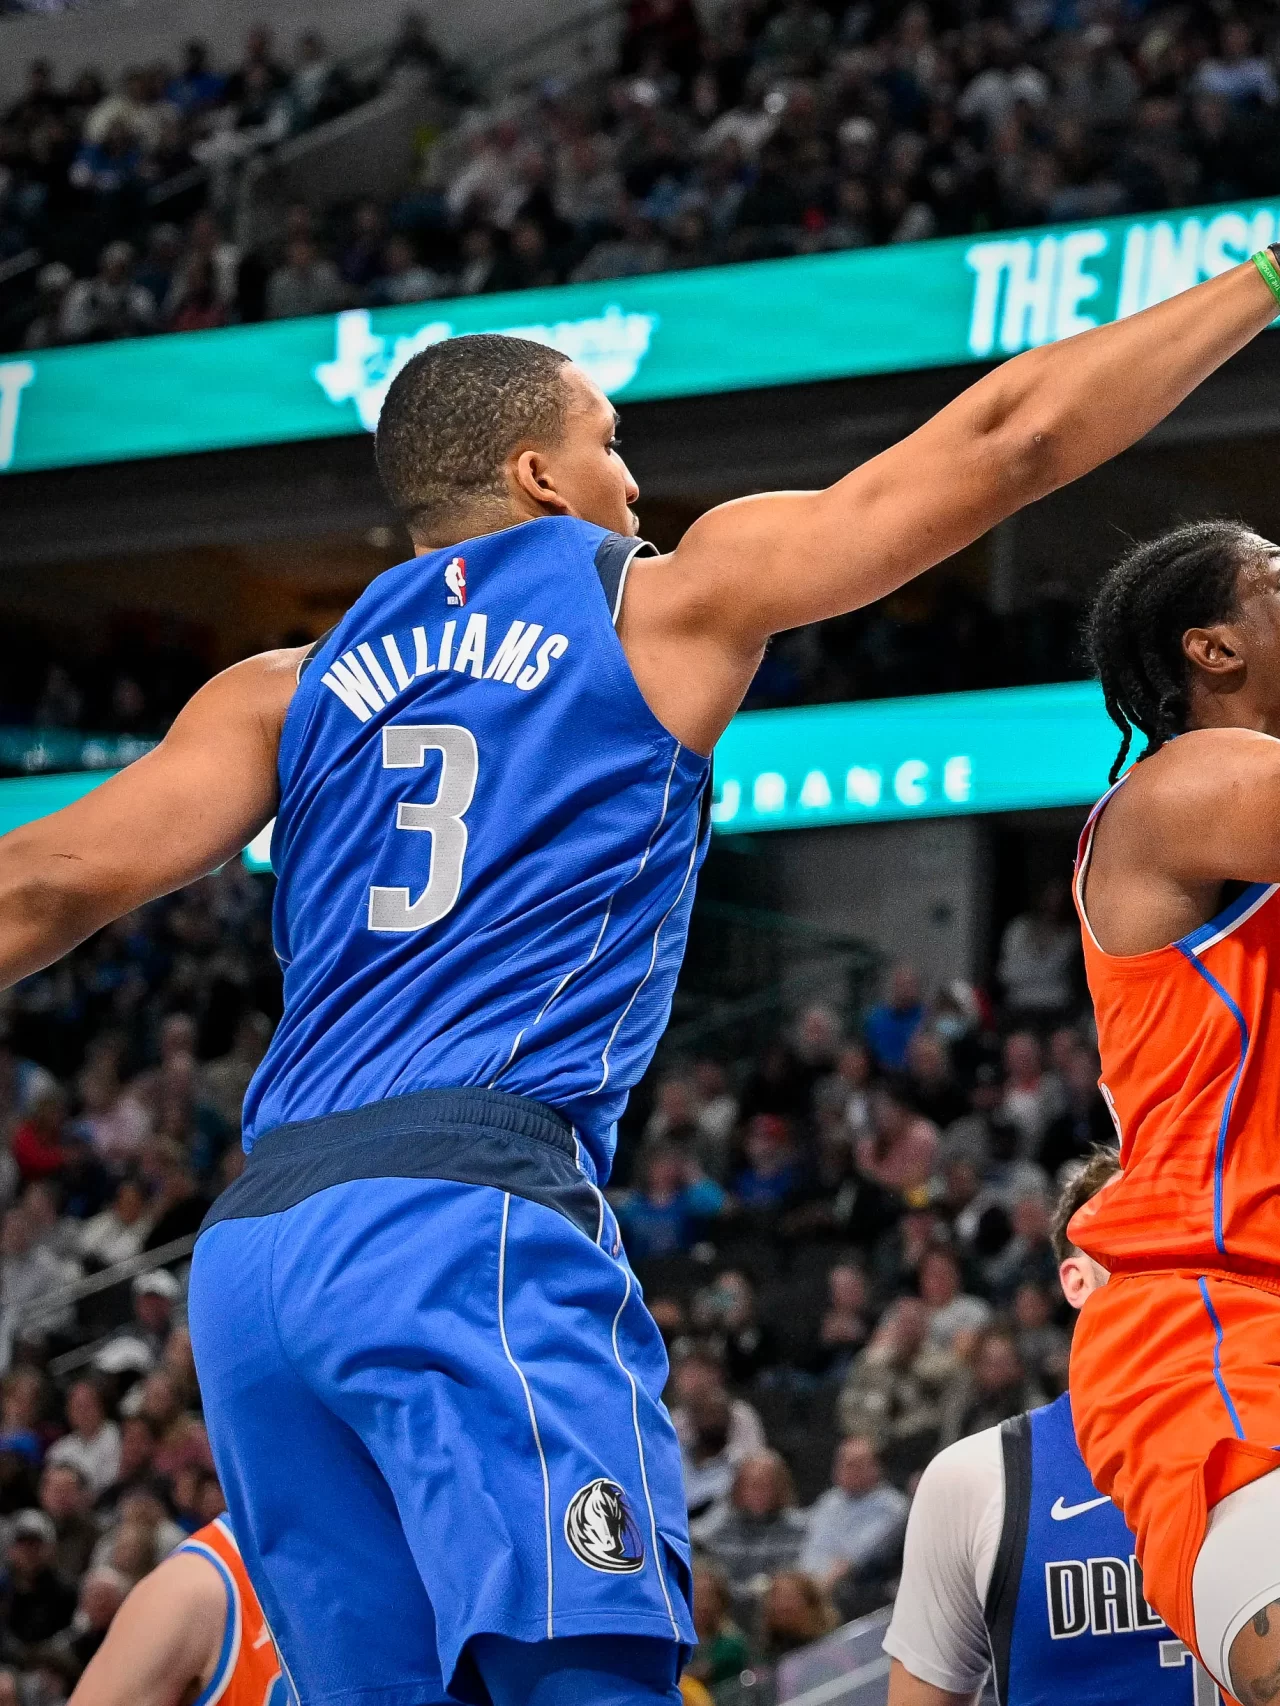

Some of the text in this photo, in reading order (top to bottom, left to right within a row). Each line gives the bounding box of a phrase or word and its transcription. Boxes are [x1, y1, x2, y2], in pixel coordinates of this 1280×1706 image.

[966, 222, 1109, 356] THE
[320, 612, 569, 723] WILLIAMS
[368, 725, 479, 931] 3
